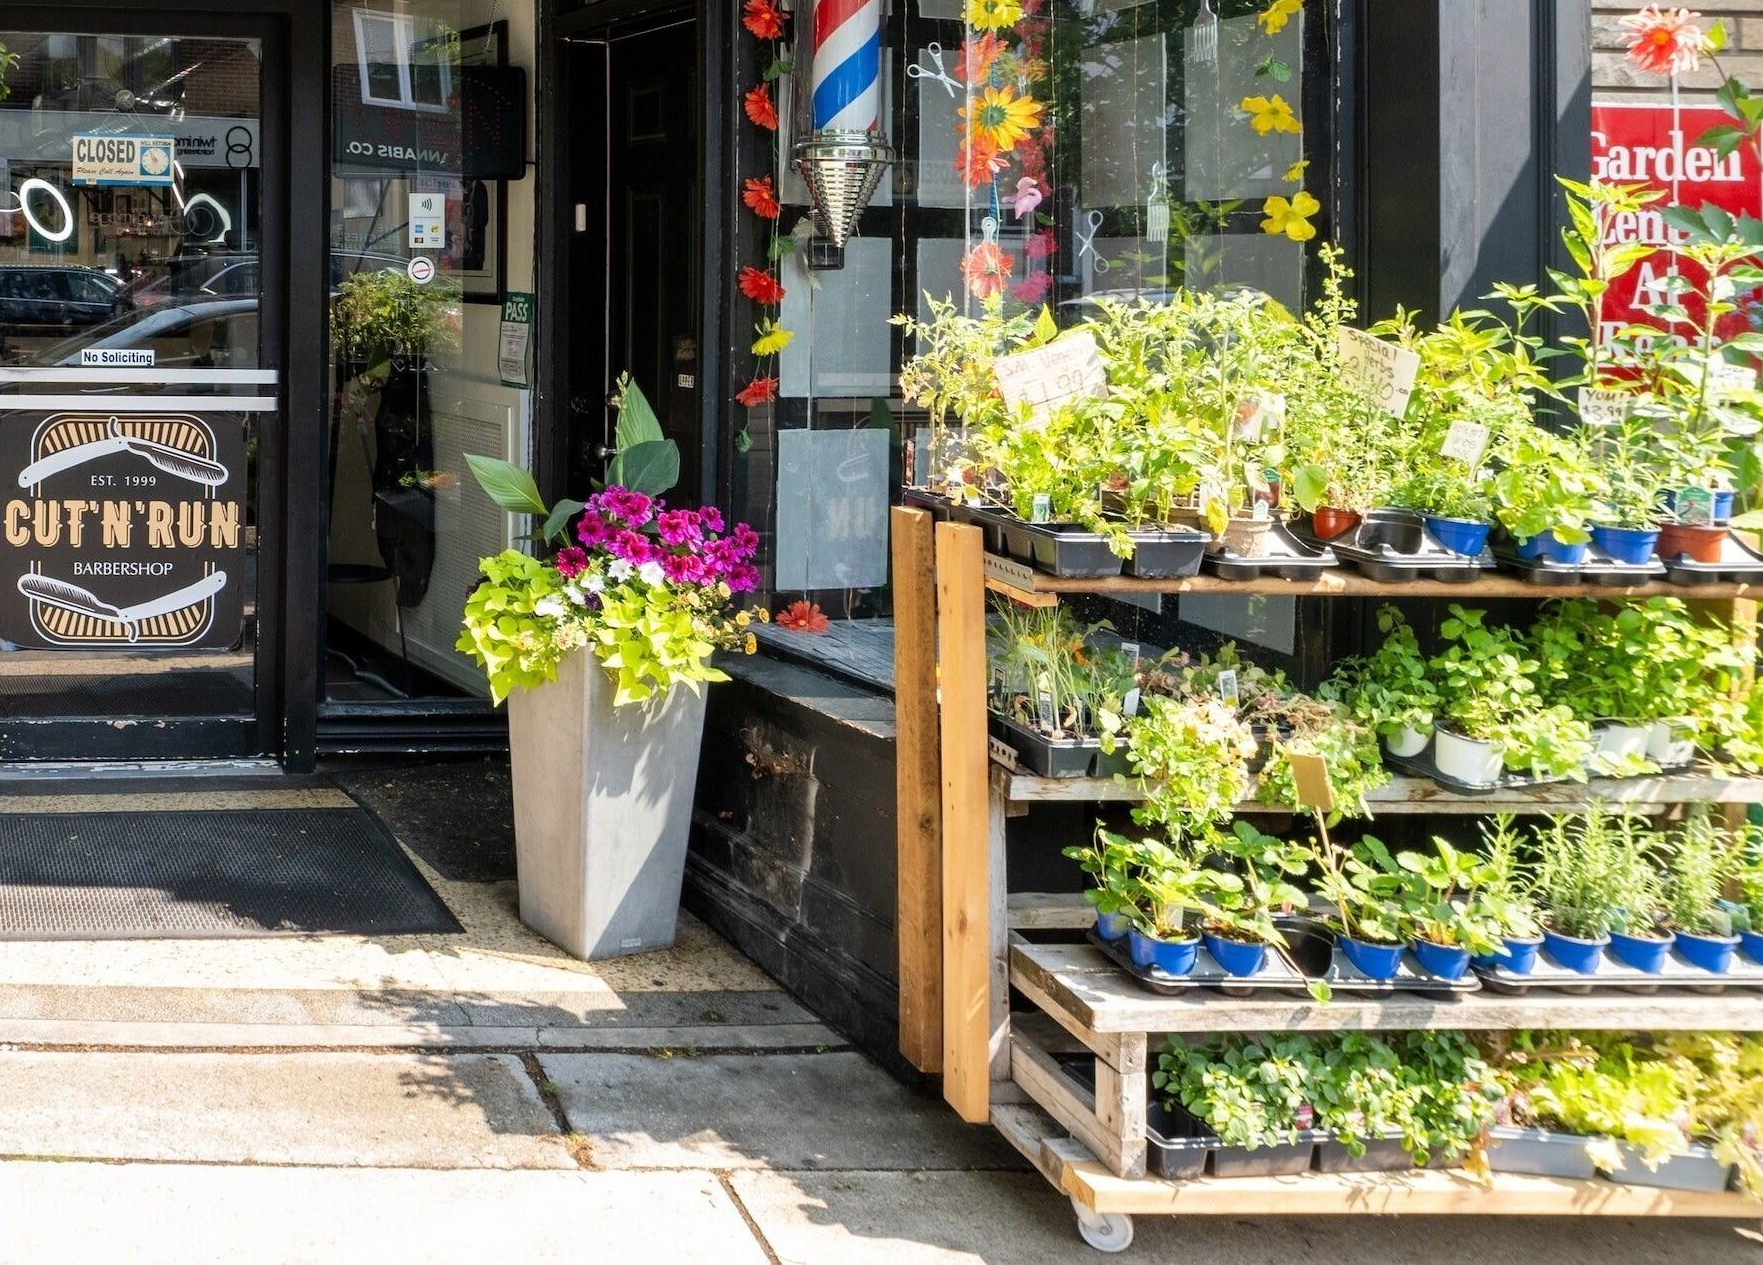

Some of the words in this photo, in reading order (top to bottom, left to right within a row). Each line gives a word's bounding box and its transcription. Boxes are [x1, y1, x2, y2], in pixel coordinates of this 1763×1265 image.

[76, 138, 136, 164] CLOSED
[505, 301, 529, 322] PASS
[83, 350, 99, 363] No
[101, 350, 154, 365] Soliciting
[91, 475, 116, 487] EST.
[125, 475, 156, 487] 1999
[3, 499, 241, 549] CUT'N'RUN
[73, 562, 174, 576] BARBERSHOP
